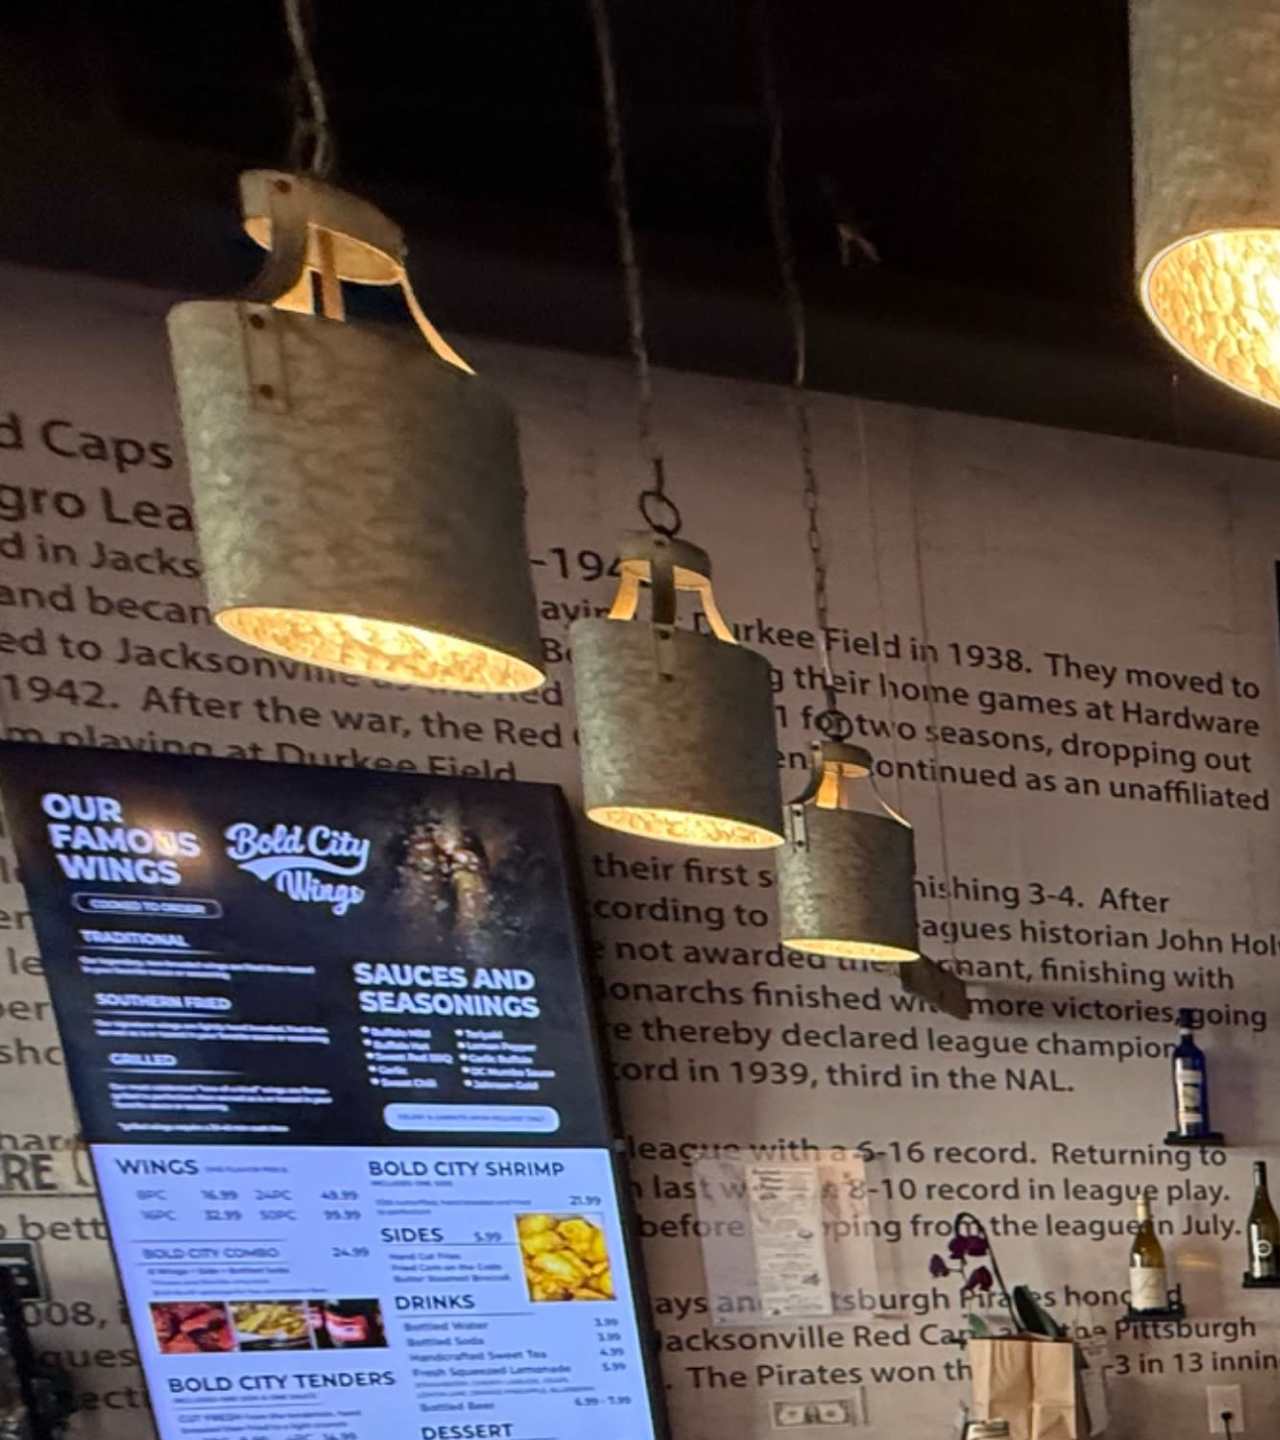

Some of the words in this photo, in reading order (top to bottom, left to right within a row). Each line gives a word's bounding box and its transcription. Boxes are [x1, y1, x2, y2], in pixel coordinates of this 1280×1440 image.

[41, 419, 174, 474] Caps
[37, 534, 77, 566] in
[58, 633, 102, 661] to
[821, 625, 900, 659] Field
[911, 638, 938, 662] in
[949, 643, 1032, 674] 1938.
[1045, 652, 1117, 689] They
[1126, 667, 1224, 697] moved
[1231, 676, 1260, 701] to
[3, 673, 119, 710] 1942.
[142, 685, 243, 720] After
[255, 696, 321, 727] the
[331, 710, 410, 738] war,
[421, 711, 483, 742] the
[494, 719, 562, 748] Red
[794, 666, 871, 696] their
[880, 672, 970, 706] home
[978, 689, 1078, 716] games
[1086, 700, 1114, 722] at
[1122, 700, 1260, 737] Hardware
[859, 714, 916, 741] two
[926, 723, 1052, 757] seasons,
[1061, 733, 1196, 773] dropping
[1205, 752, 1252, 773] out
[870, 757, 1017, 789] ontinued
[1026, 772, 1056, 792] as
[1065, 776, 1100, 796] an
[1110, 780, 1270, 811] unaffiliated
[41, 793, 123, 823] OUR
[48, 823, 202, 858] FAMOUS
[224, 823, 305, 861] Bold
[307, 825, 370, 864] City
[57, 854, 182, 886] WINGS
[592, 853, 673, 882] their
[684, 858, 748, 887] first
[1029, 882, 1085, 908] 3-4.
[1100, 887, 1170, 914] After
[275, 869, 365, 916] Wings
[735, 904, 768, 927] to
[1021, 919, 1148, 950] historian
[1157, 928, 1223, 954] John
[353, 962, 468, 988] SAUCES
[473, 967, 536, 991] AND
[616, 940, 674, 963] not
[1041, 957, 1165, 992] finishing
[1174, 967, 1234, 990] with
[359, 990, 541, 1018] SEASONINGS
[602, 979, 744, 1006] onarchs
[754, 981, 881, 1012] finished
[970, 997, 1044, 1018] more
[1190, 1007, 1267, 1031] going
[642, 1016, 772, 1051] thereby
[782, 1023, 917, 1052] declared
[928, 1031, 1028, 1058] league
[688, 1059, 719, 1083] in
[730, 1061, 818, 1088] 1939,
[827, 1063, 901, 1088] third
[912, 1066, 939, 1090] in
[947, 1067, 996, 1090] the
[1006, 1069, 1075, 1093] NAL.
[115, 1158, 199, 1176] WINGS
[368, 1160, 428, 1177] BOLD
[434, 1160, 479, 1177] CITY
[486, 1160, 565, 1177] SHRIMP
[934, 1142, 1036, 1165] record.
[1052, 1143, 1192, 1170] Returning
[1199, 1146, 1227, 1167] to
[926, 1178, 1020, 1201] record
[1029, 1179, 1054, 1200] in
[1064, 1179, 1158, 1205] league
[1167, 1181, 1230, 1209] play.
[381, 1227, 445, 1243] SIDES
[991, 1216, 1037, 1237] the
[1183, 1215, 1242, 1241] July.
[395, 1294, 475, 1311] DRINKS
[854, 1325, 911, 1347] Red
[1115, 1317, 1256, 1345] Pittsburgh
[169, 1377, 233, 1393] BOLD
[239, 1374, 289, 1391] CITY
[293, 1370, 396, 1389] TENDERS
[686, 1366, 747, 1389] The
[756, 1363, 862, 1388] Pirates
[870, 1364, 937, 1384] won
[1139, 1354, 1164, 1375] in
[1176, 1353, 1203, 1373] 13
[421, 1423, 513, 1440] DESSERT
